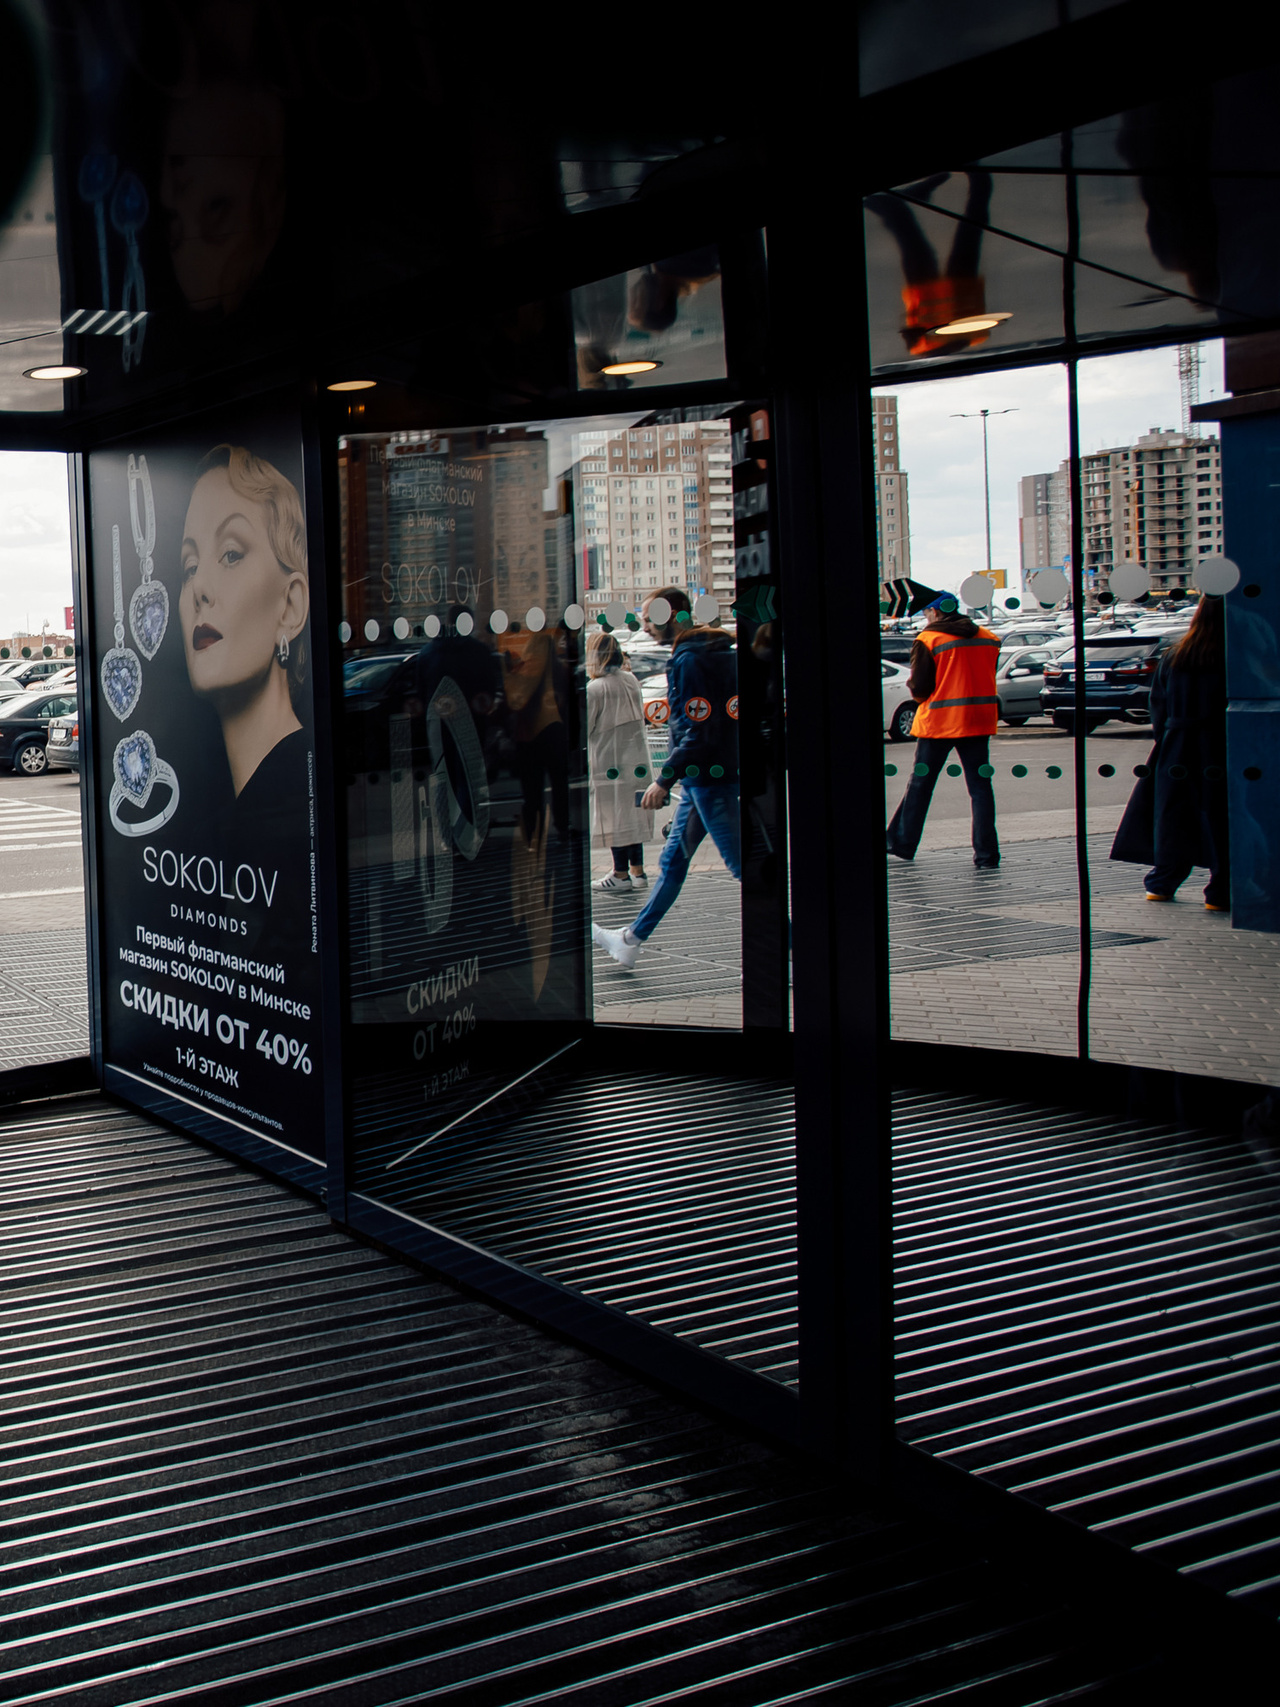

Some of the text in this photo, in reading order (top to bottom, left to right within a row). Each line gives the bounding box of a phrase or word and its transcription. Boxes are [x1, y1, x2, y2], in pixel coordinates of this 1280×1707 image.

[428, 483, 476, 507] SOKOLOV
[381, 562, 482, 604] SOKOLOV
[143, 846, 279, 908] SOKOLOV
[309, 852, 317, 913] Литвинова
[170, 903, 248, 936] DIAMONDS
[310, 914, 318, 953] Рената
[119, 947, 312, 1021] магазин SOKOLOV в Минске
[136, 925, 286, 985] Первый флагманский
[406, 954, 479, 1015] СКИДКИ
[120, 979, 313, 1076] СКИДКИ ОТ 40%
[412, 1002, 477, 1061] ОТ 40%
[175, 1046, 240, 1089] 1-Й ЭТАЖ
[422, 1058, 470, 1101] 1-Й ЭТАЖ
